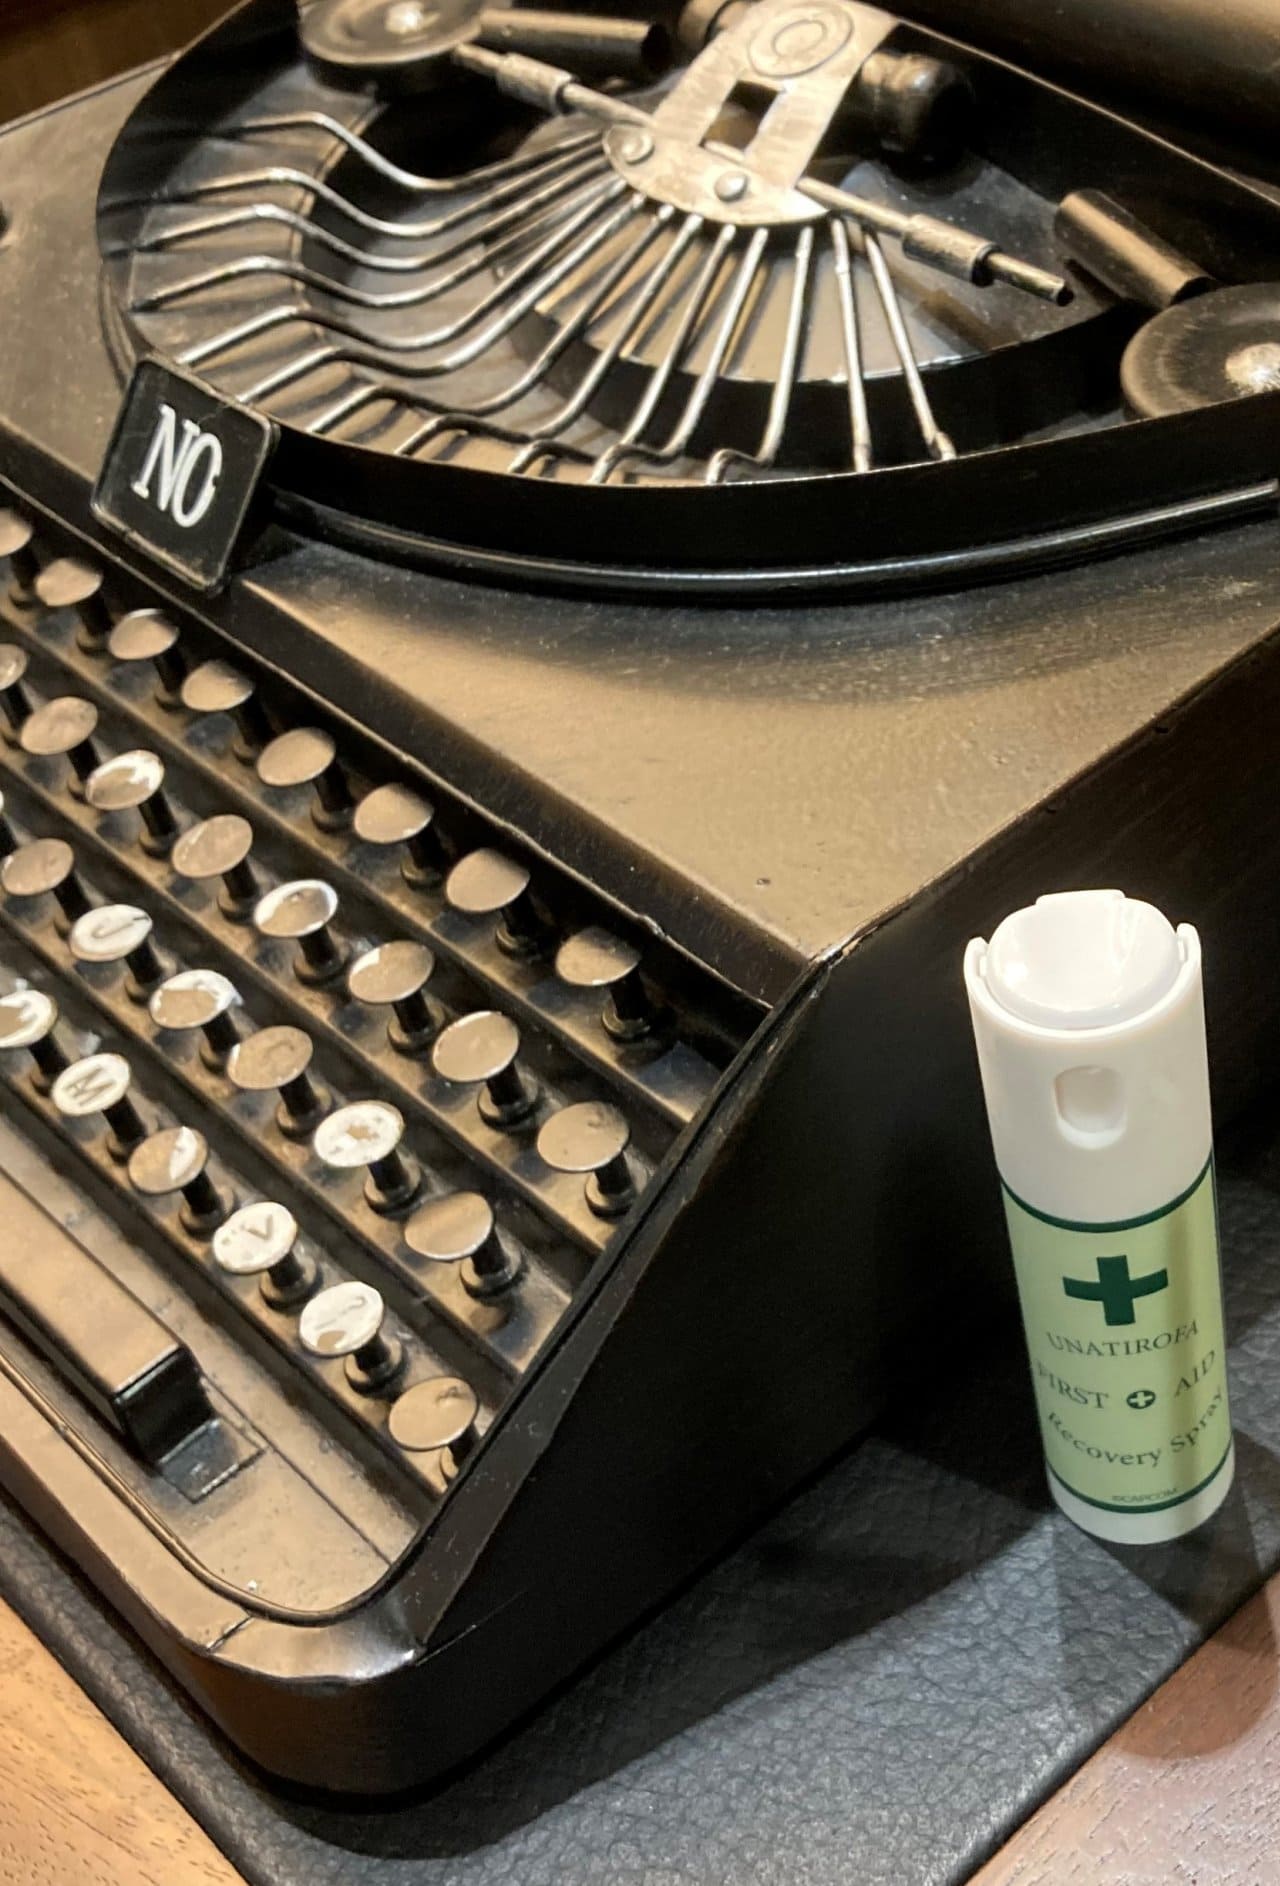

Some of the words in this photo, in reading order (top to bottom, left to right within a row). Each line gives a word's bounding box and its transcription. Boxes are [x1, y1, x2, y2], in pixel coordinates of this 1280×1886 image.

[131, 403, 223, 528] NO
[1036, 1359, 1109, 1409] FIRST
[1174, 1350, 1216, 1398] AID
[1048, 1412, 1162, 1468] Recovery
